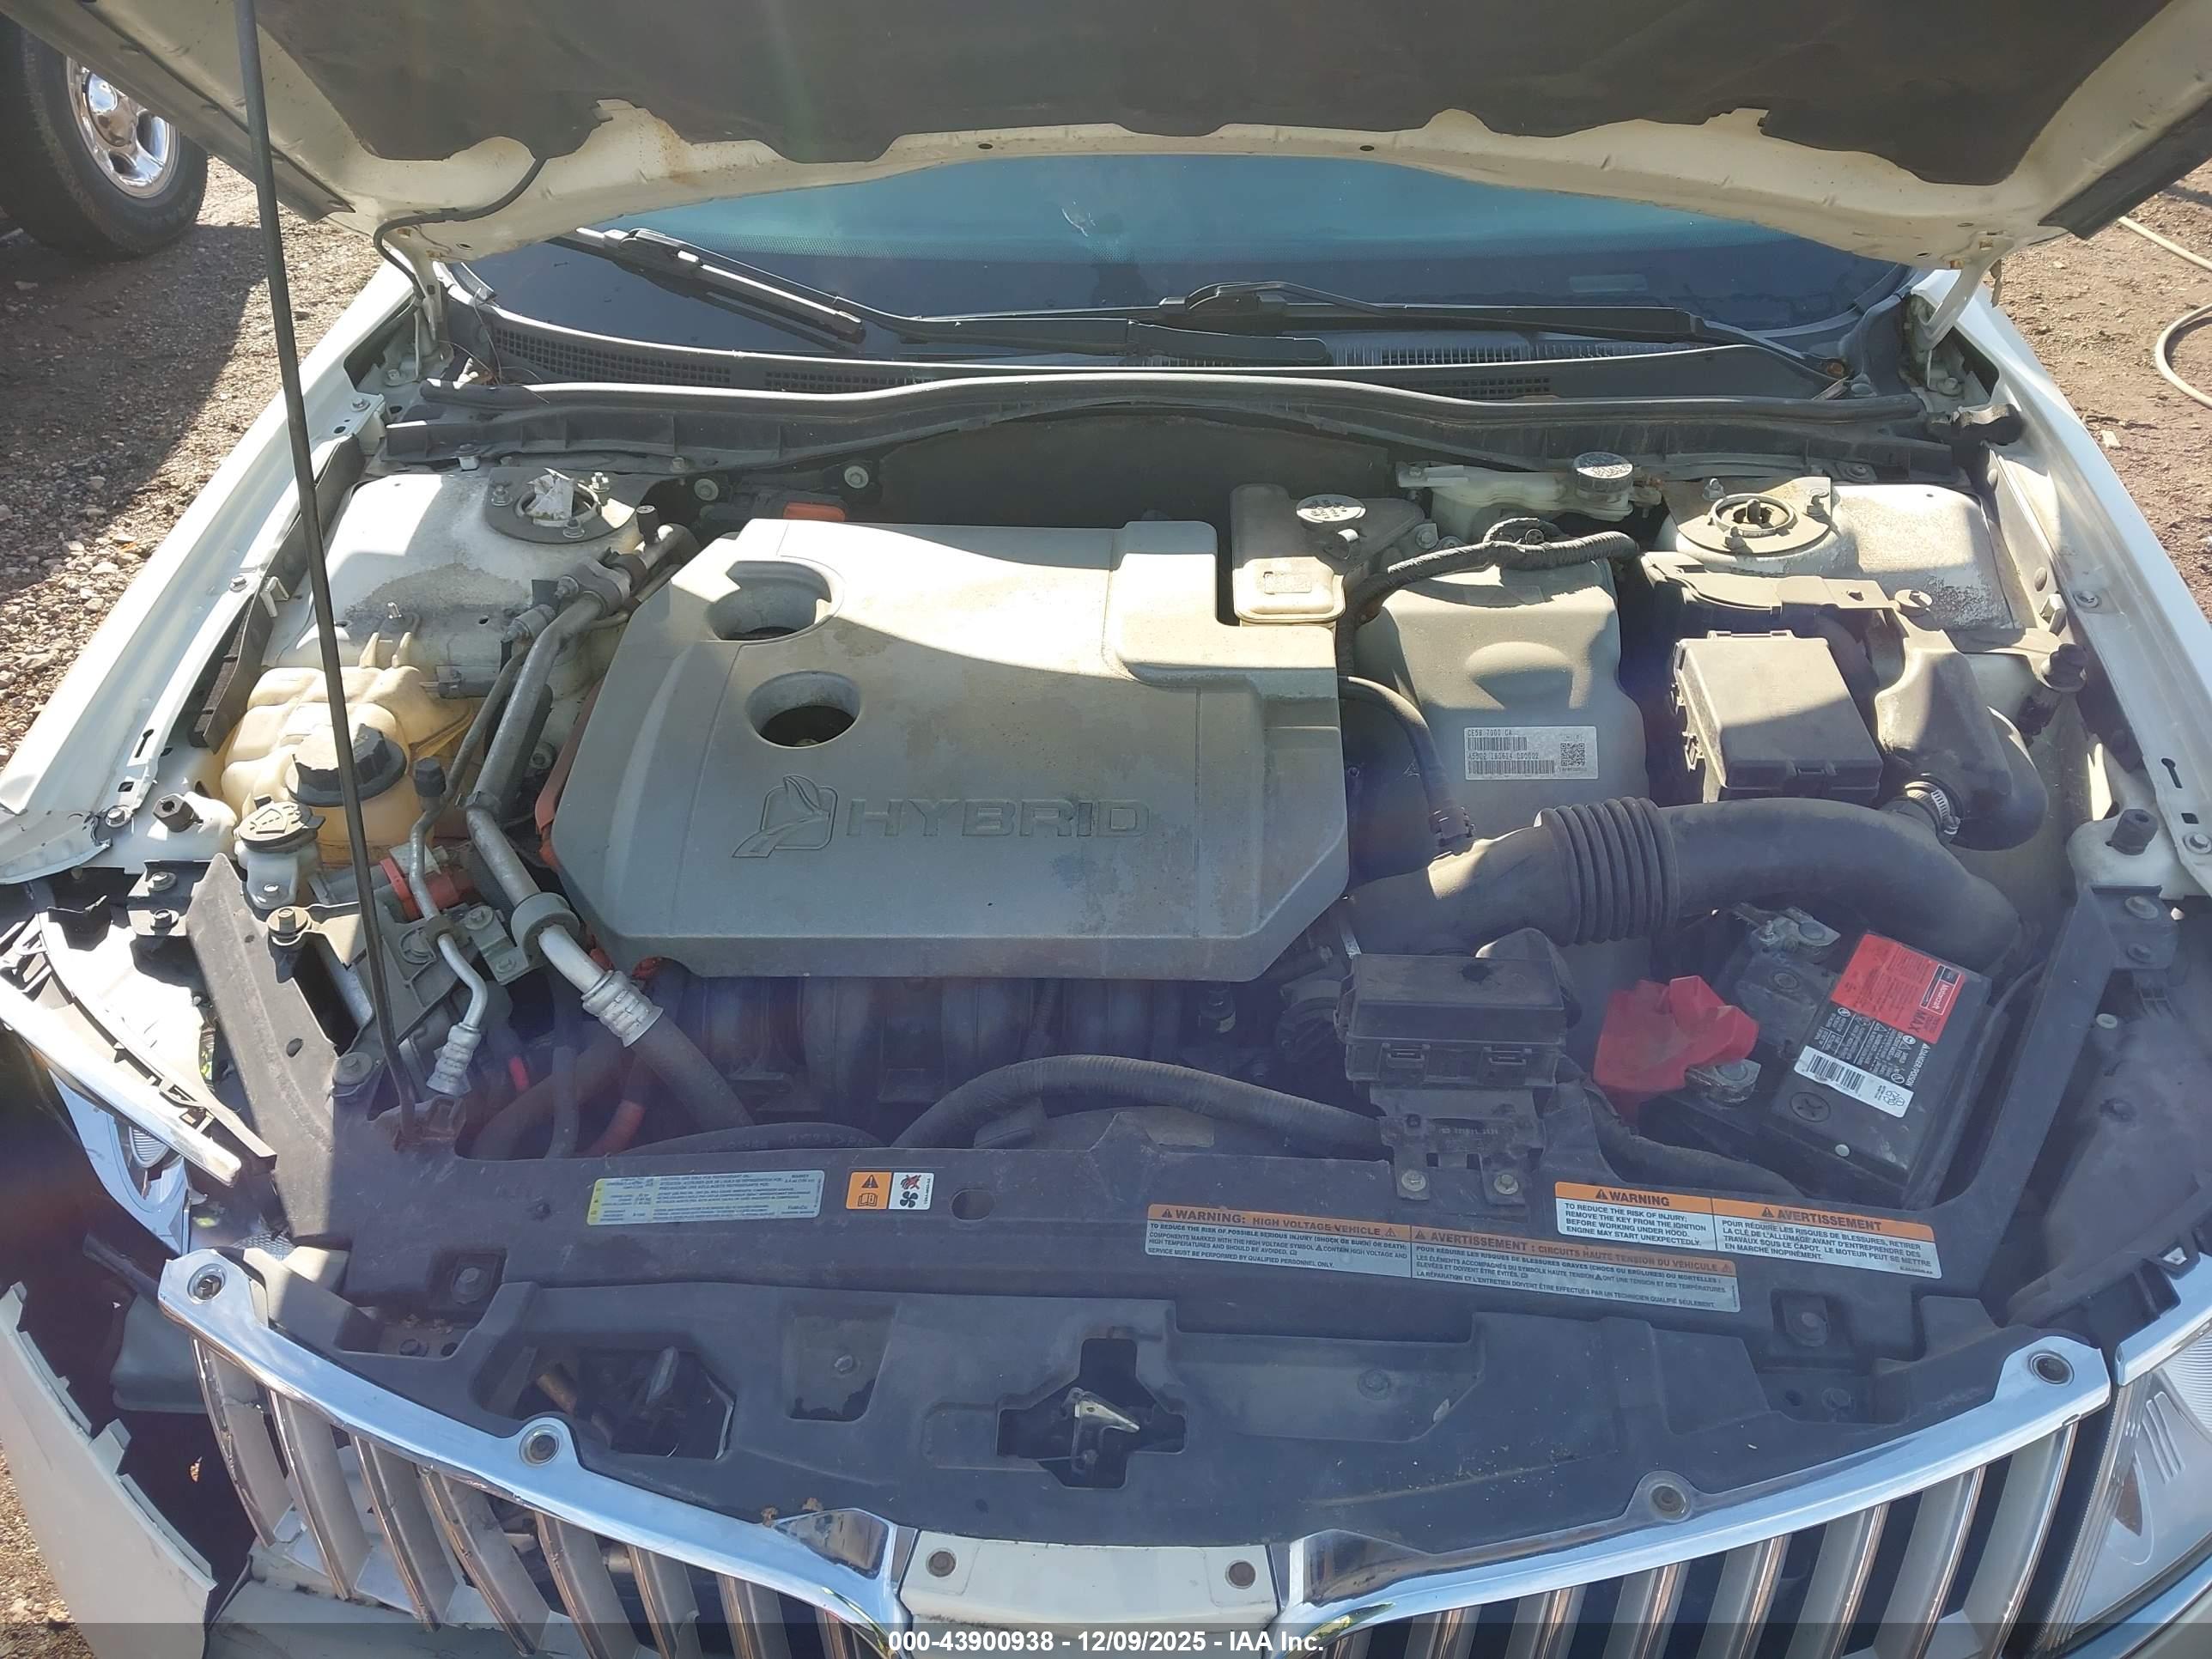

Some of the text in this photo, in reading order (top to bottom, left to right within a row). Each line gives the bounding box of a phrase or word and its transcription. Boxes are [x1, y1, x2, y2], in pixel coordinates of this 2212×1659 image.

[846, 799, 1150, 837] HYBRID
[1930, 982, 1949, 1012] Motorcraft
[1907, 1007, 1928, 1034] MAX
[1905, 1047, 1929, 1088] DANGER/POISON
[1577, 1204, 1607, 1212] REDUCE
[1609, 1191, 1669, 1206] WARNING
[1176, 1209, 1380, 1235] WARNING: HIGH VOLTAGE VEHICLE
[1565, 1210, 1596, 1219] REMOVE
[1673, 1220, 1705, 1231] IGNITION
[1565, 1218, 1596, 1227] BEFORE
[1598, 1221, 1635, 1231] WORKING
[1637, 1224, 1663, 1234] UNDER
[1778, 1209, 1881, 1231] AVERTISSEMENT
[1149, 1231, 1189, 1240] COMPONENTS
[1164, 1239, 1211, 1248] TEMPERATURES
[1566, 1226, 1595, 1235] ENGINE
[1614, 1231, 1638, 1239] START
[1763, 1231, 1810, 1243] L'ALLUMAGE
[1812, 1237, 1836, 1246] AVANT
[1838, 1241, 1904, 1255] D'ENTREPRENDRE
[1795, 1228, 1828, 1237] RISQUES
[1889, 1240, 1920, 1249] RETIRER
[1431, 1232, 1527, 1250] AVERTISSEMENT
[1539, 1245, 1579, 1256] CIRCUITS
[1583, 1249, 1613, 1260] HAUTE
[1615, 1253, 1654, 1265] TENSION
[1657, 1258, 1669, 1267] DU
[1723, 1235, 1758, 1244] TRAVAUX
[1835, 1248, 1868, 1258] MOTEUR
[1869, 1252, 1888, 1261] PEUT
[1901, 1257, 1931, 1267] METTRE
[1736, 1244, 1768, 1253] MARCHE
[1481, 1252, 1510, 1261] RISQUES
[1522, 1256, 1559, 1266] BLESSURES
[1678, 1274, 1717, 1284] MORTELLES
